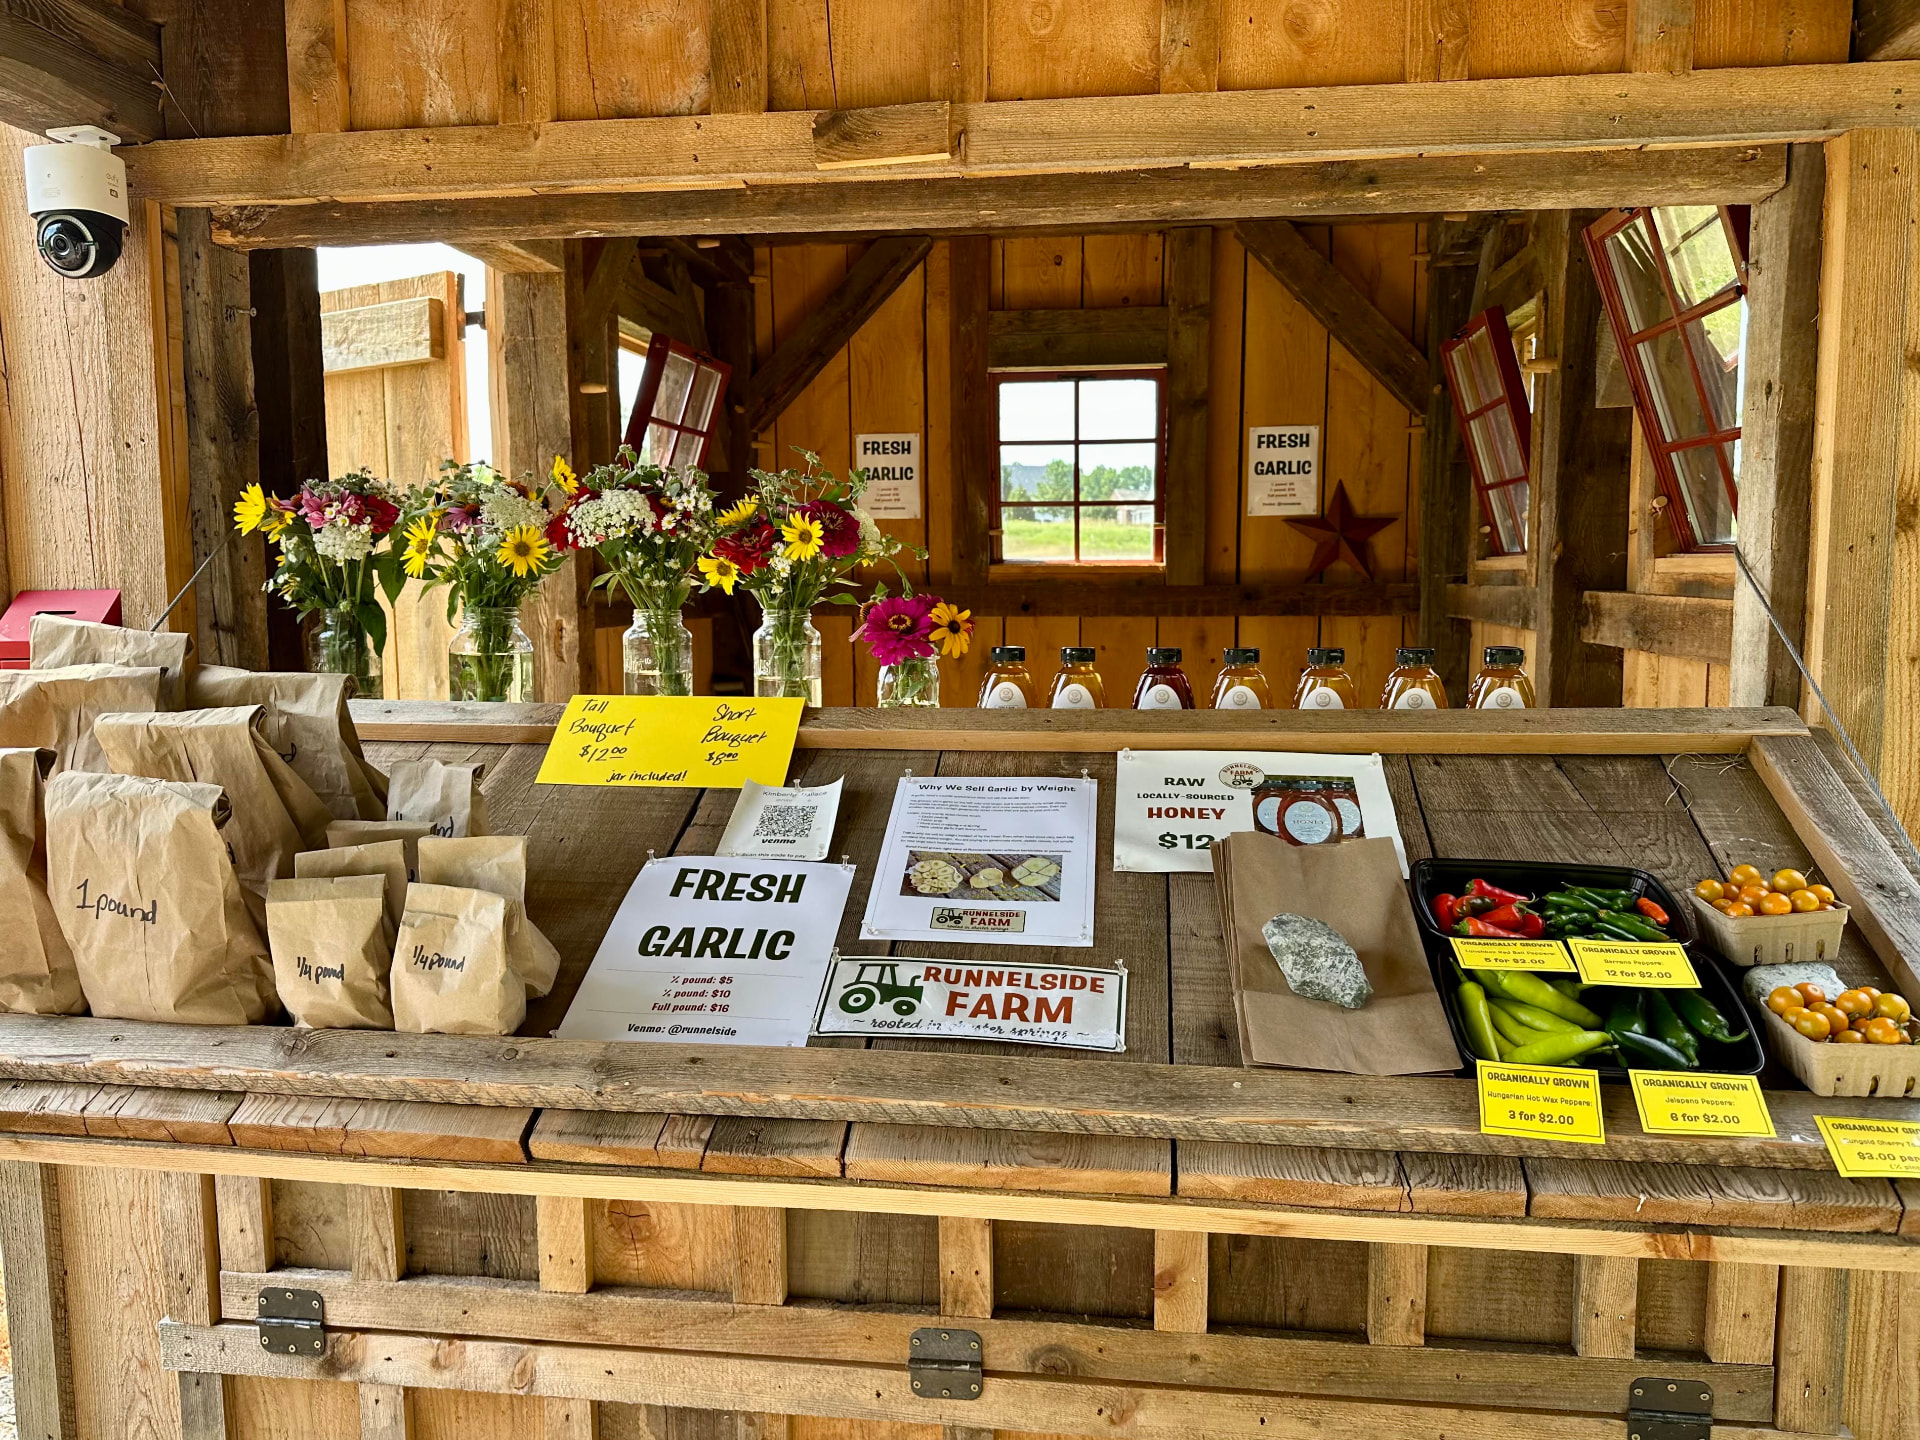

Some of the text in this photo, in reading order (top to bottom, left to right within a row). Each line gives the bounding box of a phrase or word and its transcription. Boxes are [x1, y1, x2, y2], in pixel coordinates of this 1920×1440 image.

[1256, 433, 1310, 448] FRESH
[863, 440, 911, 455] FRESH
[863, 466, 914, 480] GARLIC
[1254, 460, 1312, 476] GARLIC
[582, 698, 609, 714] Tall
[713, 704, 757, 722] Short
[568, 718, 636, 742] Bouquet
[701, 725, 768, 748] Bouquet
[606, 770, 688, 783] jar included!
[1164, 777, 1206, 786] RAW
[919, 784, 942, 792] Why
[1021, 785, 1033, 793] by
[1137, 792, 1234, 800] LOCALLY-SOURCED
[1147, 806, 1226, 820] HONEY
[669, 868, 808, 904] FRESH
[962, 910, 1020, 918] RUNNELSIDE
[970, 918, 1011, 926] FARM
[638, 925, 796, 960] GARLIC
[1582, 946, 1640, 954] ORGANICALLY
[682, 976, 716, 985] pound:
[718, 976, 734, 984] $5
[922, 966, 1104, 994] RUNNELSIDE
[1638, 970, 1672, 978] $2.00
[674, 990, 708, 998] pound:
[710, 989, 731, 998] $10
[652, 1002, 730, 1012] Full pound: $16
[944, 990, 1074, 1024] FARM
[627, 1024, 737, 1036] Venmo: @runnelside
[870, 1018, 922, 1029] rooted
[1487, 1072, 1590, 1088] ORGANICALLY GROWN
[1642, 1078, 1749, 1091] ORGANICALLY GROWN
[1487, 1090, 1524, 1100] Hungarian
[1542, 1096, 1558, 1104] Wax
[1560, 1098, 1592, 1107] Peppers:
[1701, 1098, 1735, 1106] Peppers:
[1508, 1110, 1574, 1125] 3 for $2.00
[1670, 1112, 1740, 1124] 6 for $2.00
[1832, 1123, 1899, 1134] ORGANICALLY
[1857, 1152, 1896, 1160] $3.00
